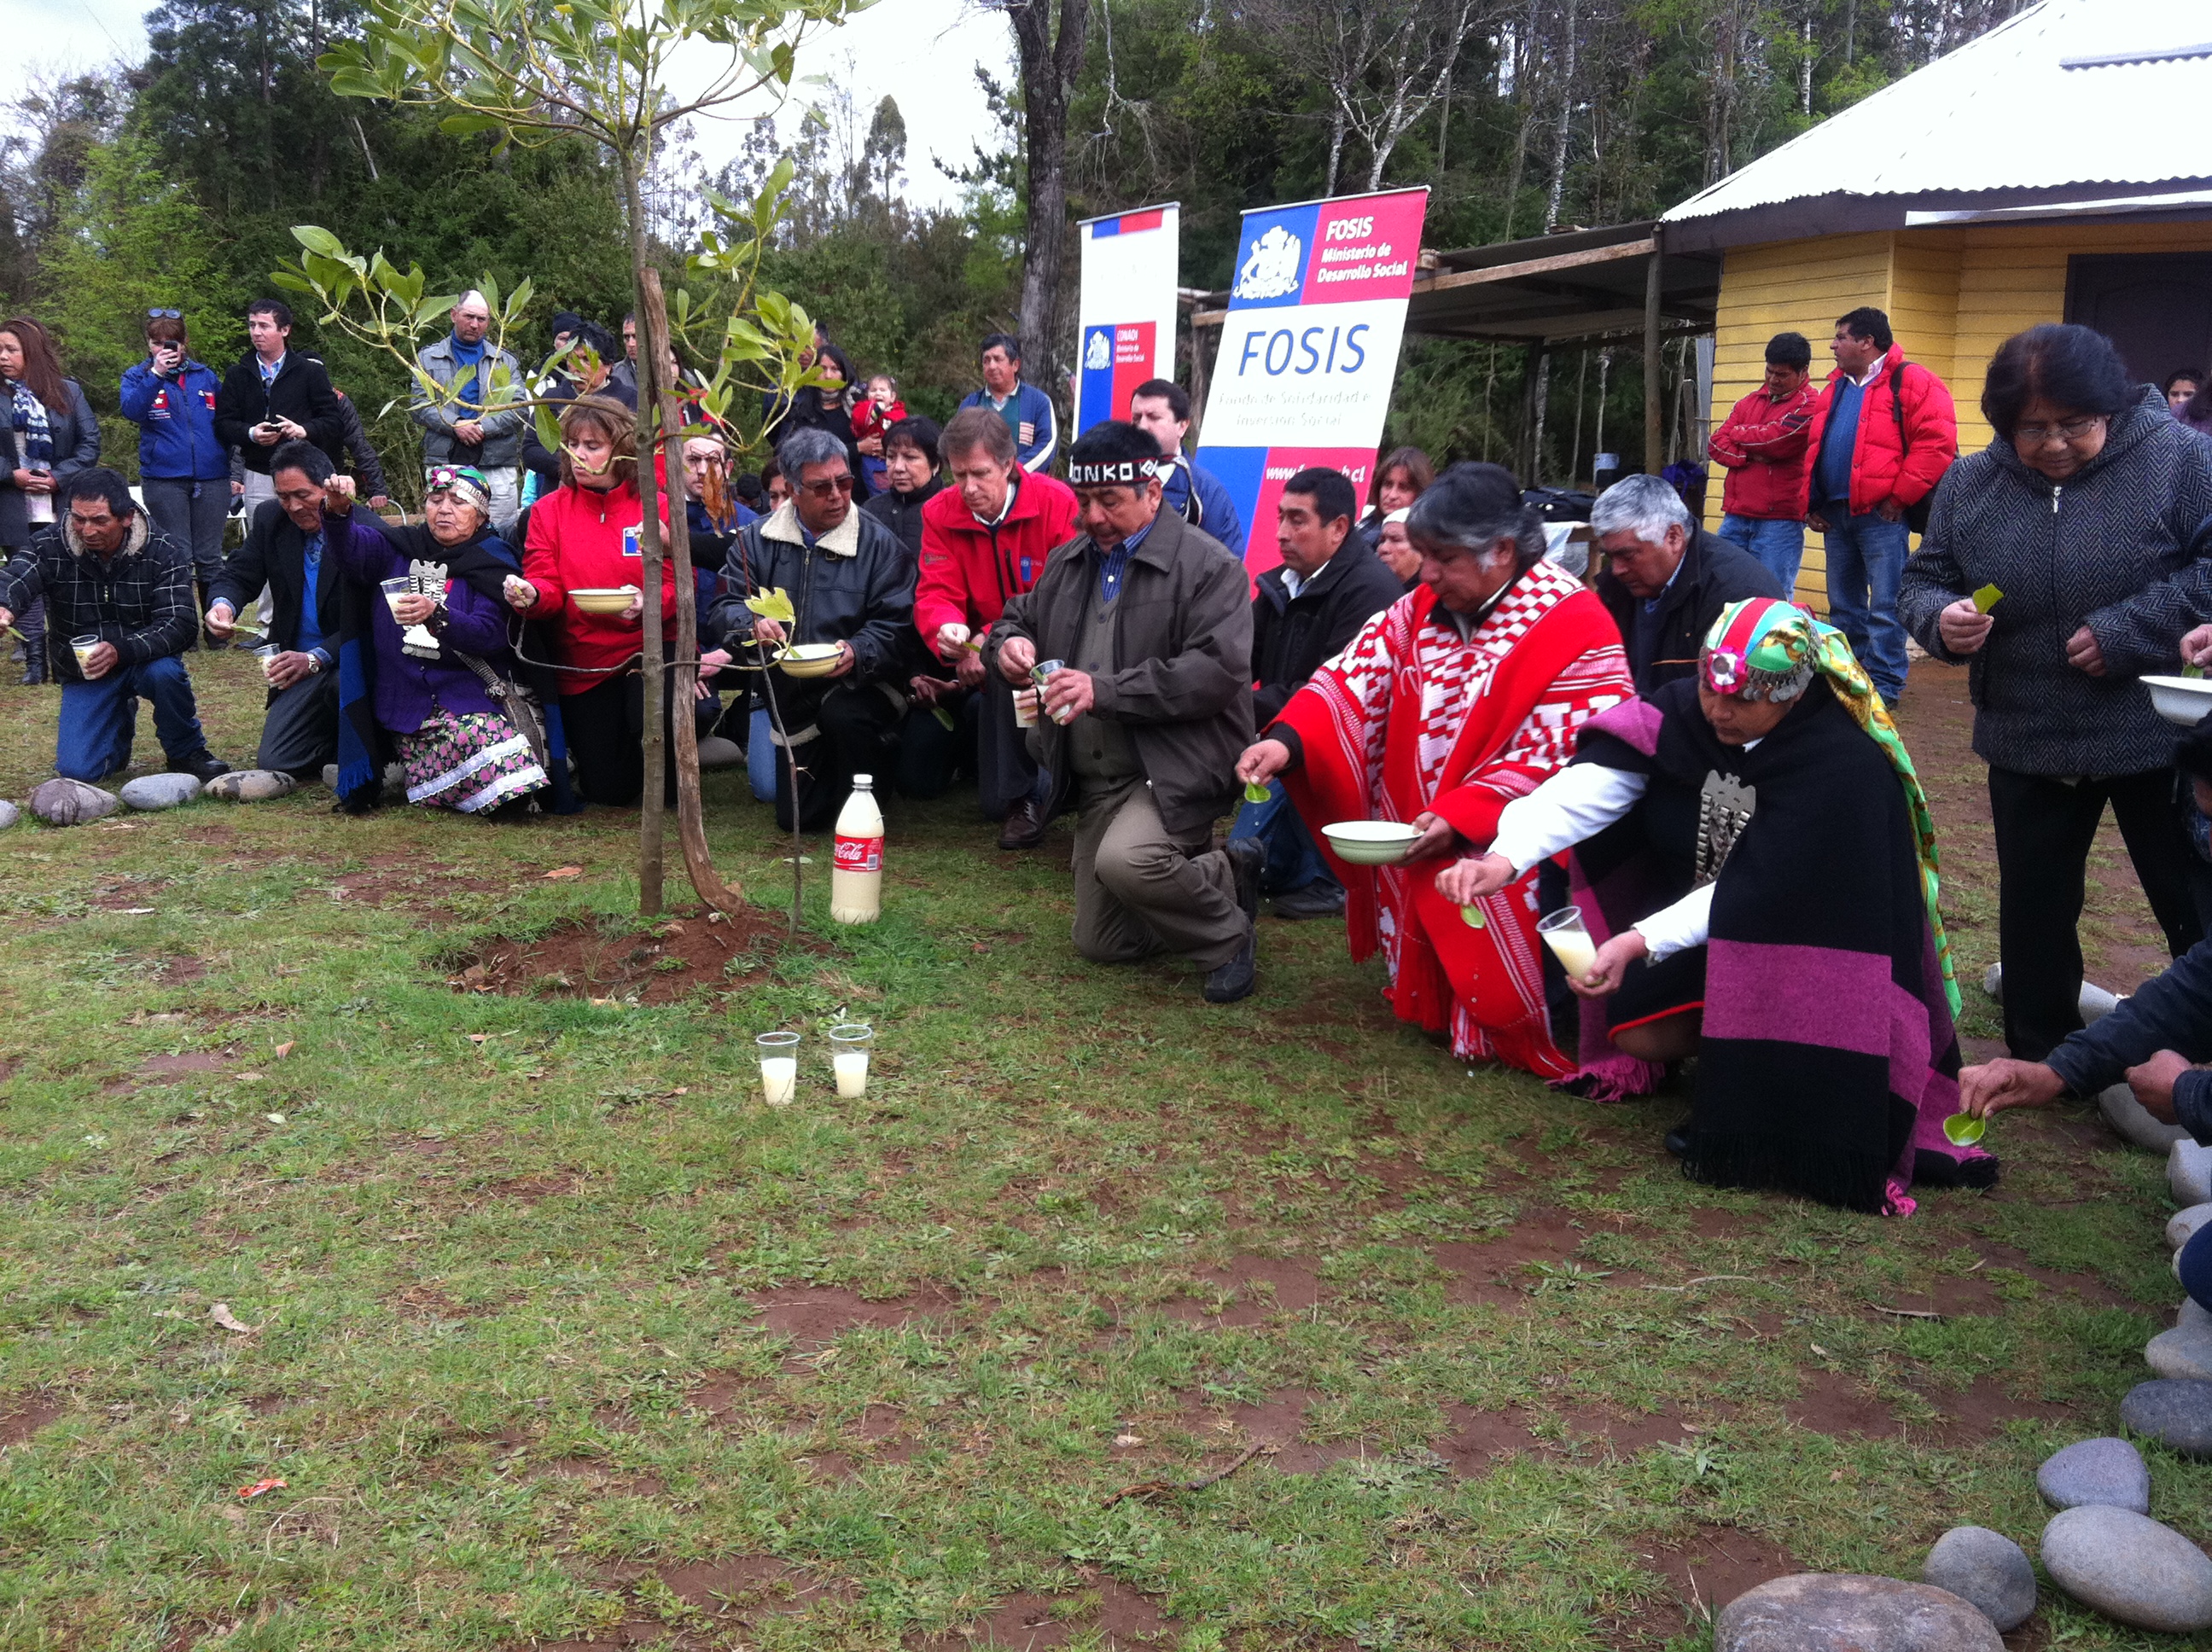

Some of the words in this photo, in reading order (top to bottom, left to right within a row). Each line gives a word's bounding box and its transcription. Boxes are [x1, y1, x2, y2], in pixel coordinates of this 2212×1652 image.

[1325, 216, 1374, 241] FOSIS
[1321, 244, 1377, 263] Ministerio
[1377, 242, 1392, 258] de
[1317, 264, 1372, 282] Desarrollo
[1372, 260, 1408, 278] Social
[1238, 323, 1371, 376] FOSIS
